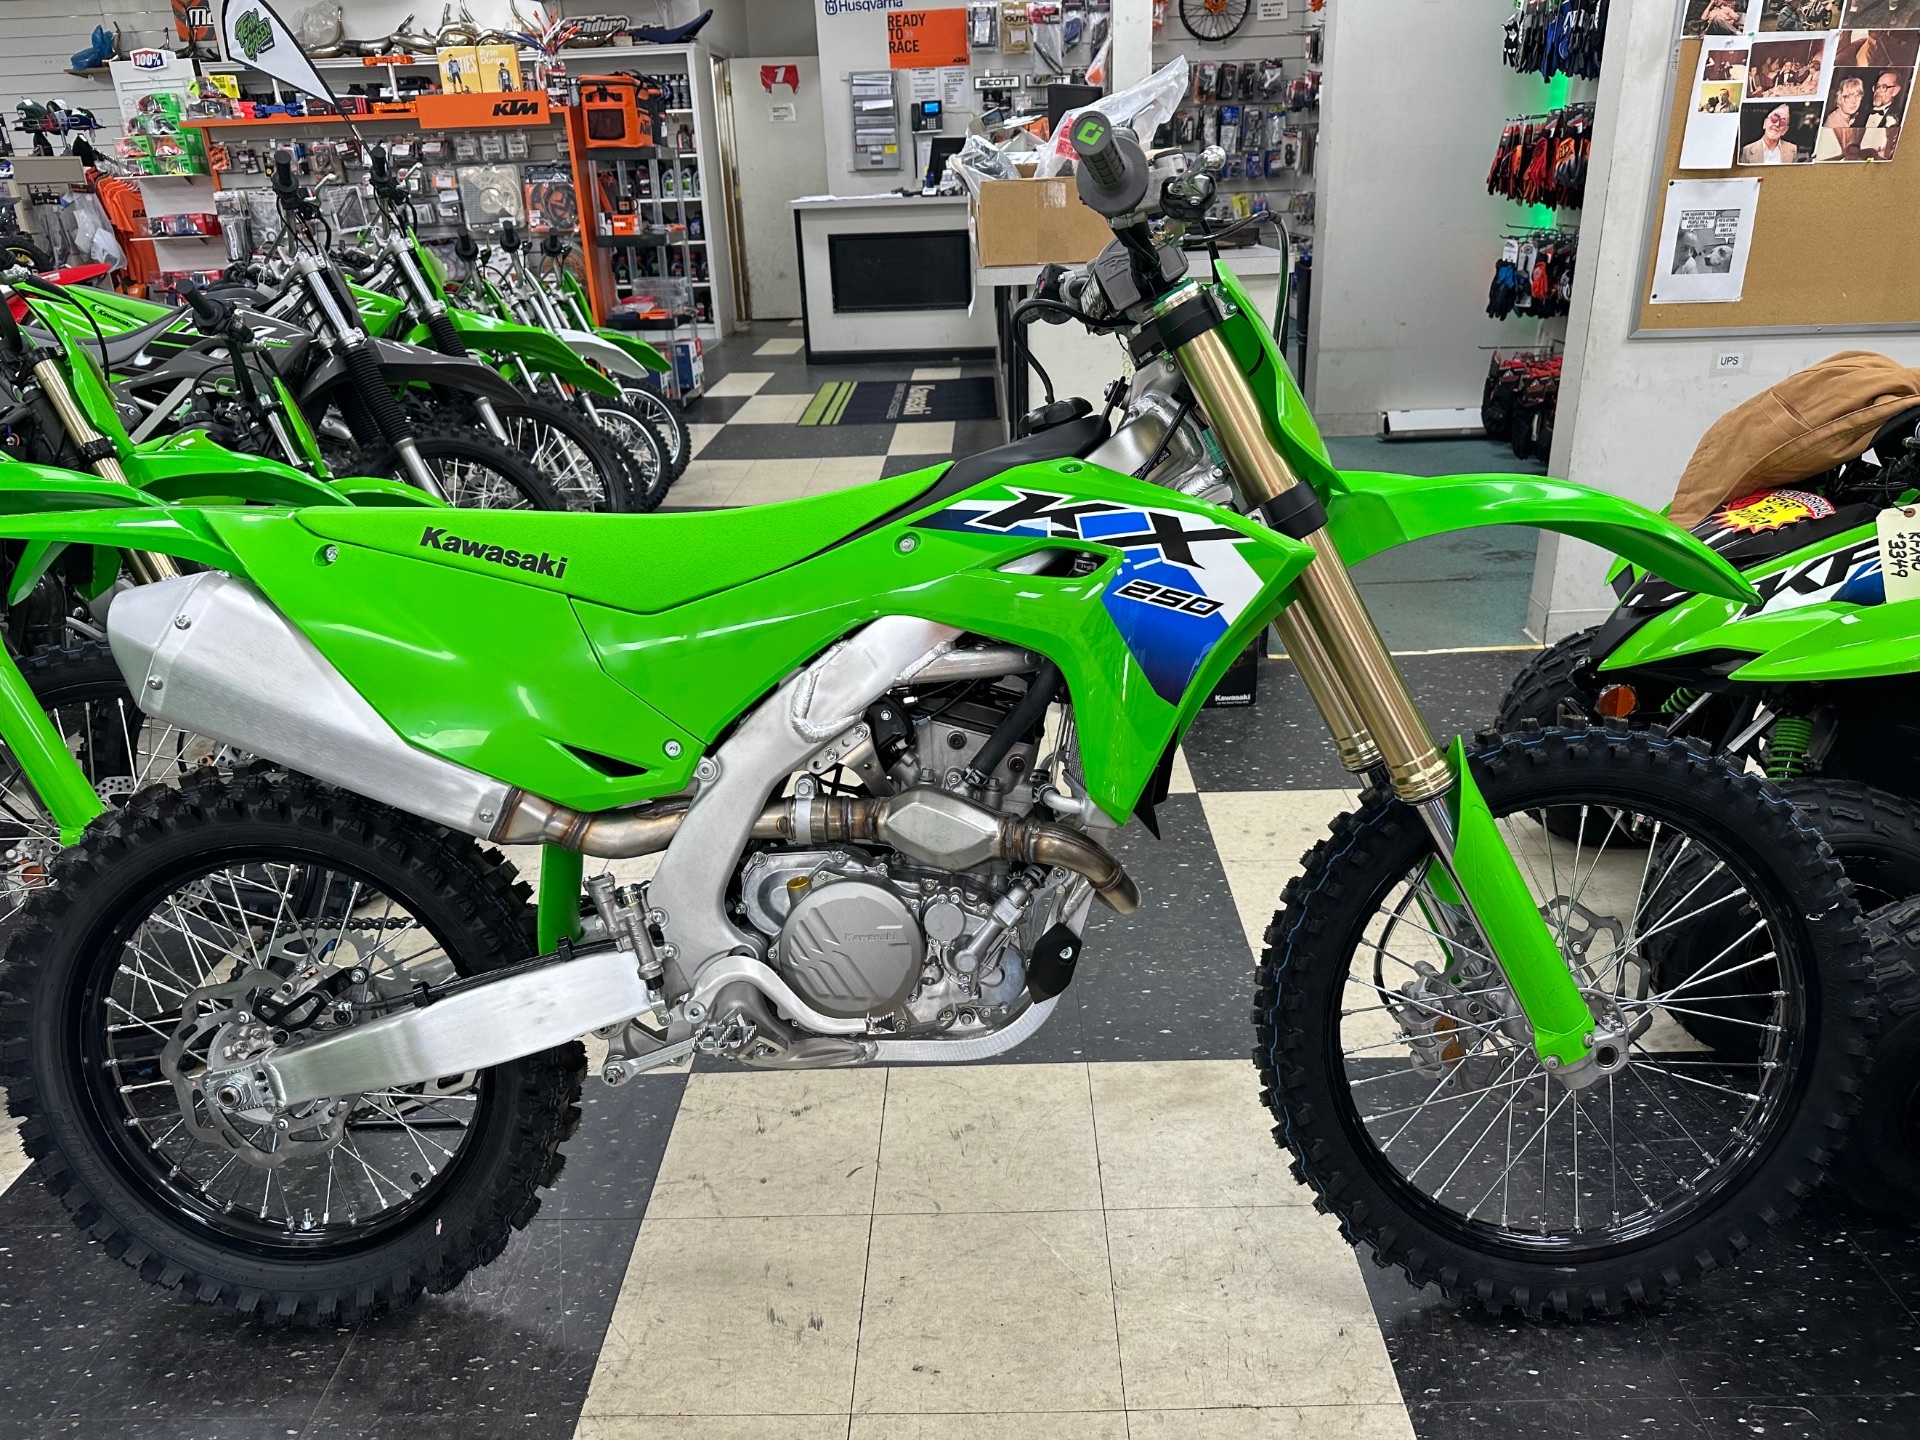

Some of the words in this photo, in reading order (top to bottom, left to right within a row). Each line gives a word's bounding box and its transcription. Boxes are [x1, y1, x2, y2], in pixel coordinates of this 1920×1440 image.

[839, 0, 904, 12] Husqvarna
[887, 13, 926, 28] READY
[889, 27, 904, 41] TO
[479, 49, 499, 58] Ryan
[889, 39, 920, 54] RACE
[135, 53, 161, 66] 100%
[979, 78, 1015, 86] SCOTT
[492, 99, 539, 116] KTM
[98, 309, 132, 329] Kawasaki
[1720, 356, 1739, 366] UPS
[975, 491, 1250, 570] KX
[420, 526, 568, 579] Kawasaki
[1116, 579, 1225, 617] 250
[1215, 693, 1251, 701] Kawasaki
[844, 931, 897, 942] Kawasaki
